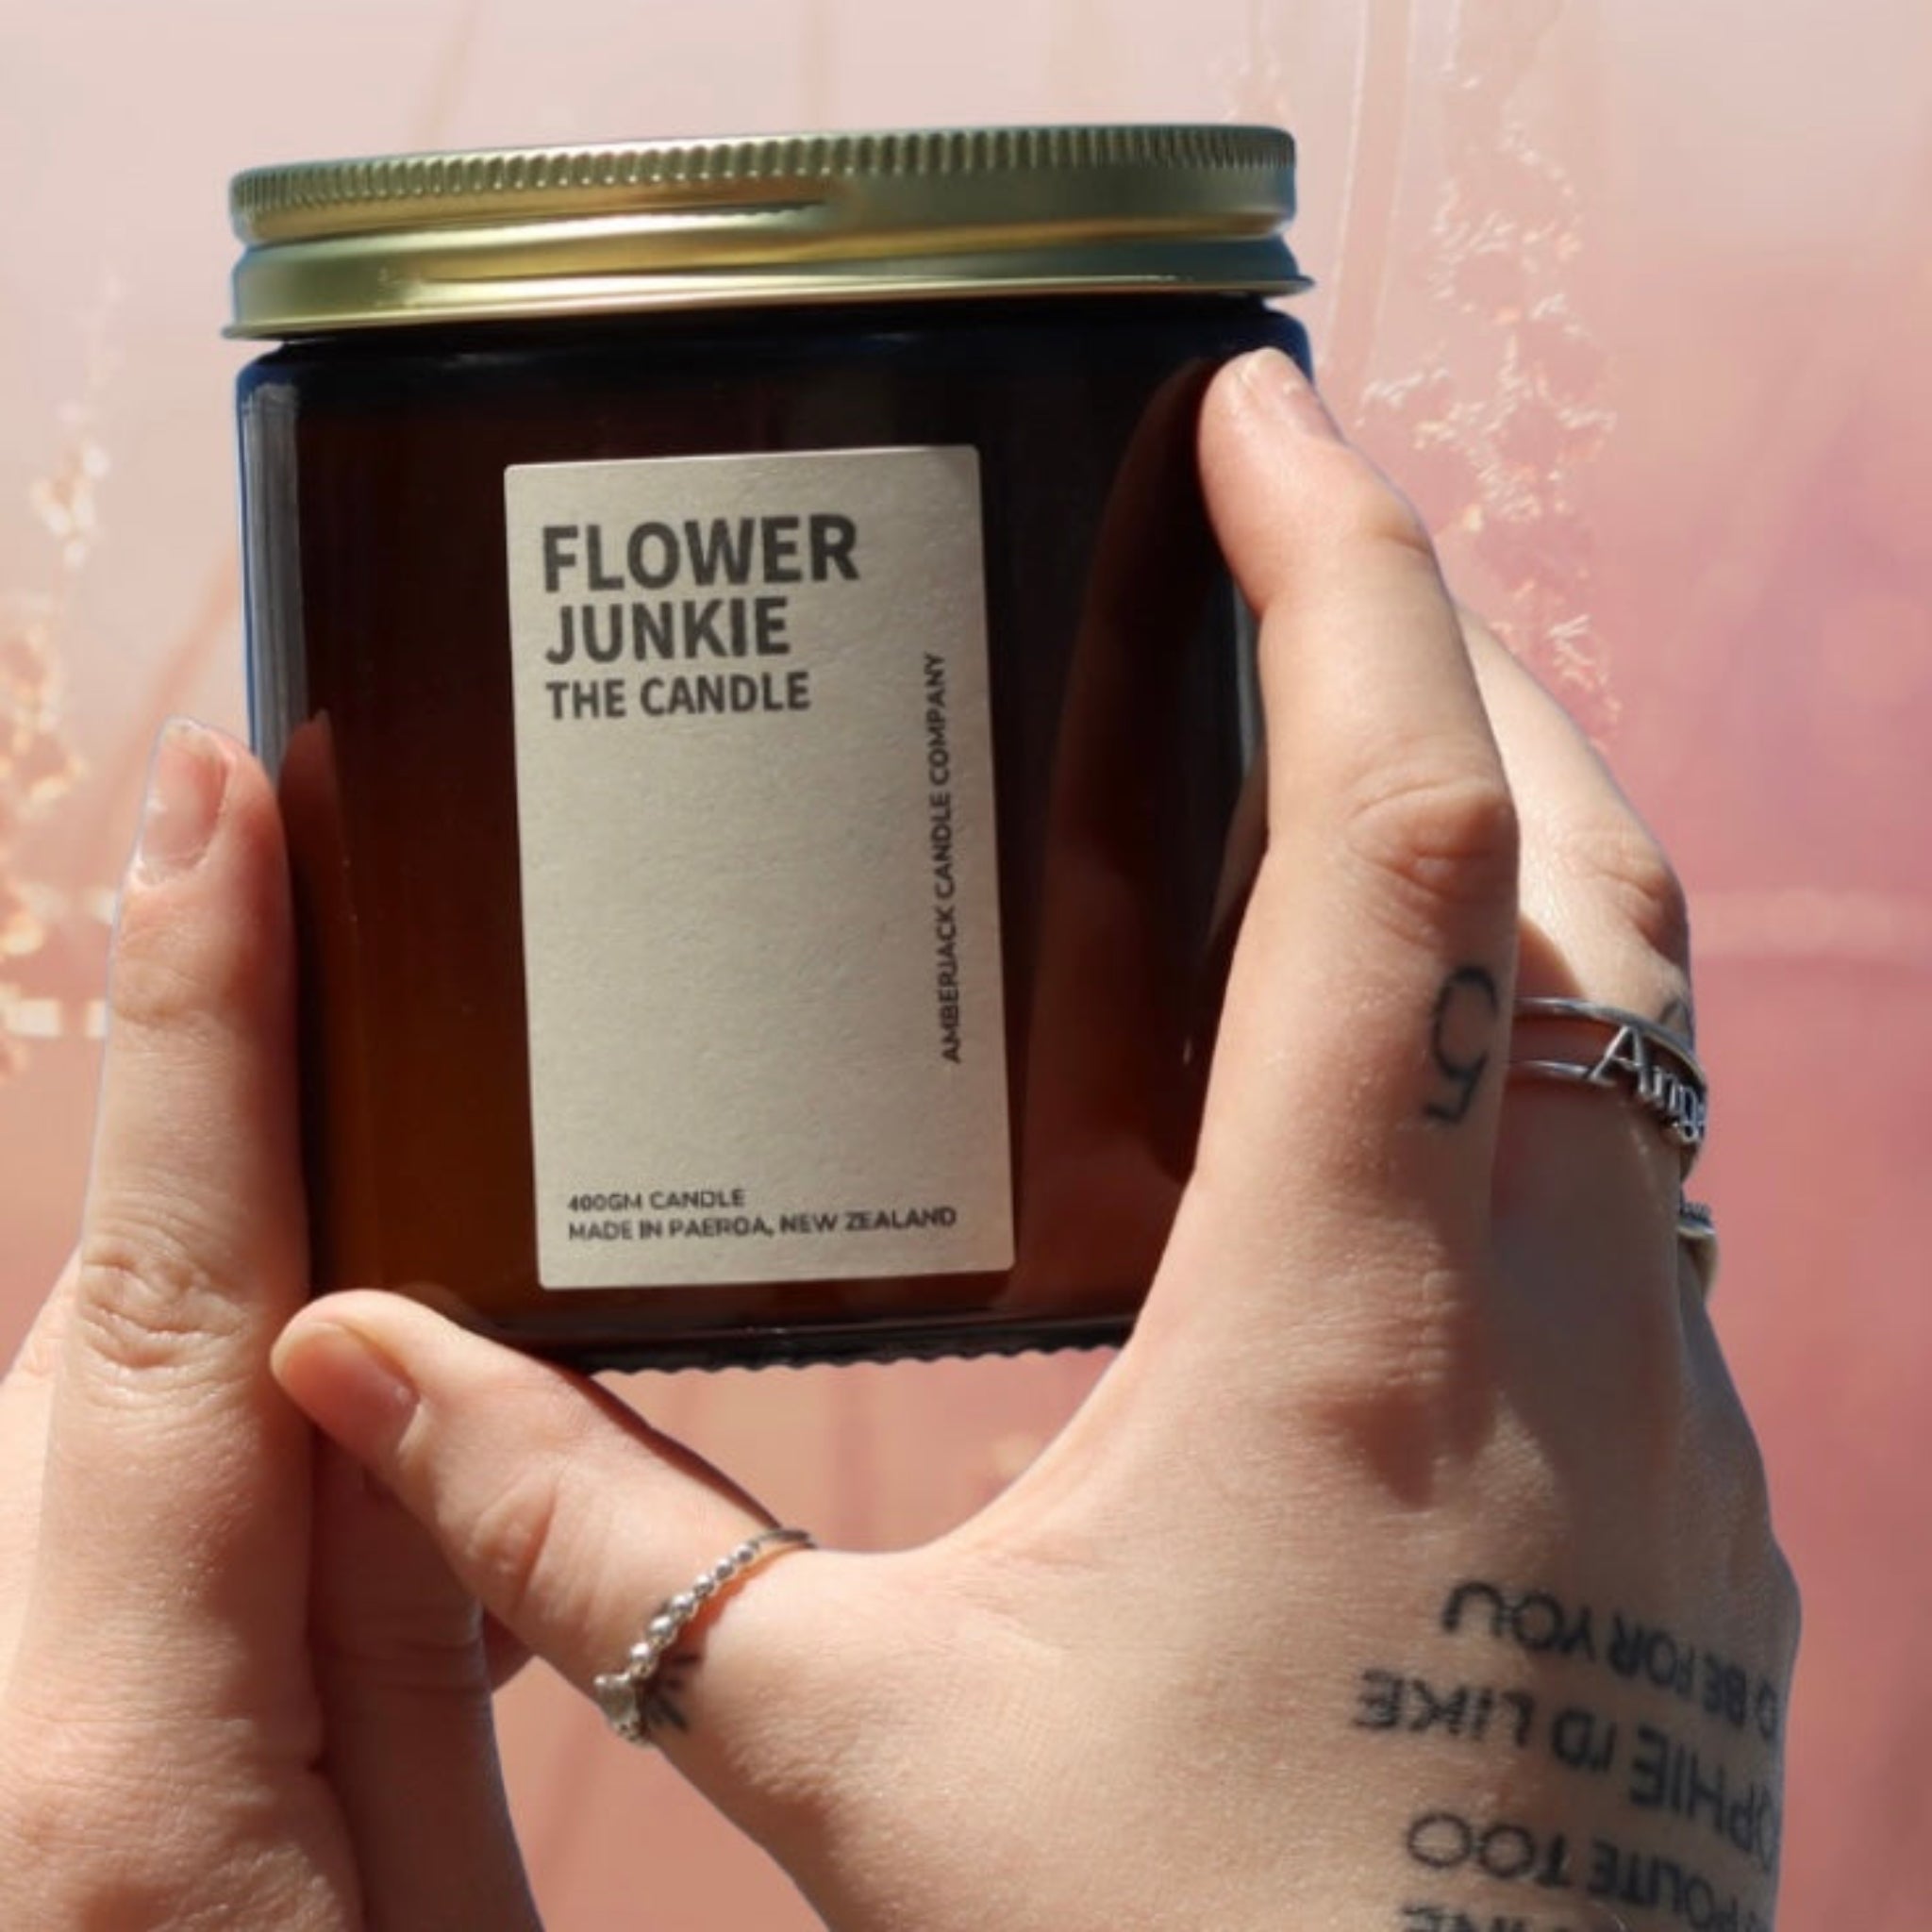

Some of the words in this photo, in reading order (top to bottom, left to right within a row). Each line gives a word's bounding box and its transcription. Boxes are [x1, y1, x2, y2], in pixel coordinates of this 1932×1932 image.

[541, 513, 860, 593] FLOWER
[545, 596, 791, 665] JUNKIE
[545, 679, 626, 720] THE
[639, 671, 811, 717] CANDLE
[924, 652, 951, 787] COMPANY
[928, 791, 957, 900] CANDLE
[933, 903, 962, 1064] AMBERJACK
[1588, 1024, 1706, 1144] Ang
[568, 1191, 643, 1212] 400GM
[649, 1188, 747, 1210] CANDLE
[569, 1220, 633, 1241] MADE
[640, 1218, 663, 1239] IN
[668, 1215, 775, 1239] PAEROA,
[779, 1213, 838, 1235] NEW
[845, 1206, 958, 1233] ZEALAND
[1441, 1580, 1597, 1663] YOU
[1607, 1609, 1696, 1697] FOR
[1353, 1667, 1538, 1747] LIKE
[1702, 1651, 1748, 1731] BE
[1406, 1811, 1572, 1889] TOO
